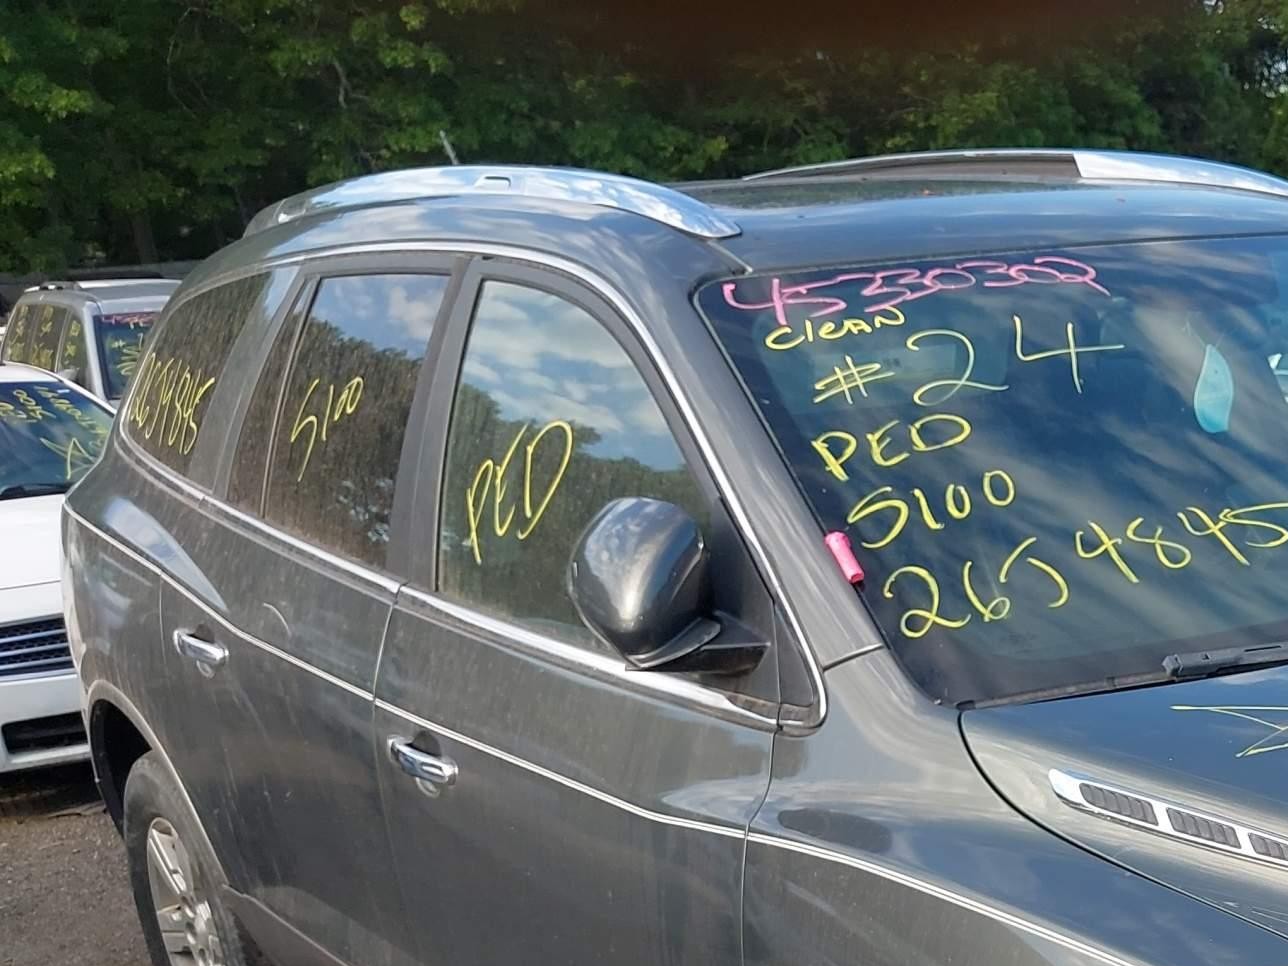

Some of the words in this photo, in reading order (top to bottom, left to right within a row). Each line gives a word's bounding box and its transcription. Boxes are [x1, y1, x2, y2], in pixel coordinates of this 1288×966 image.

[722, 256, 1110, 325] 45330302
[290, 376, 364, 483] S100
[813, 414, 971, 482] PED
[465, 419, 573, 565] PED
[847, 470, 1016, 549] S100
